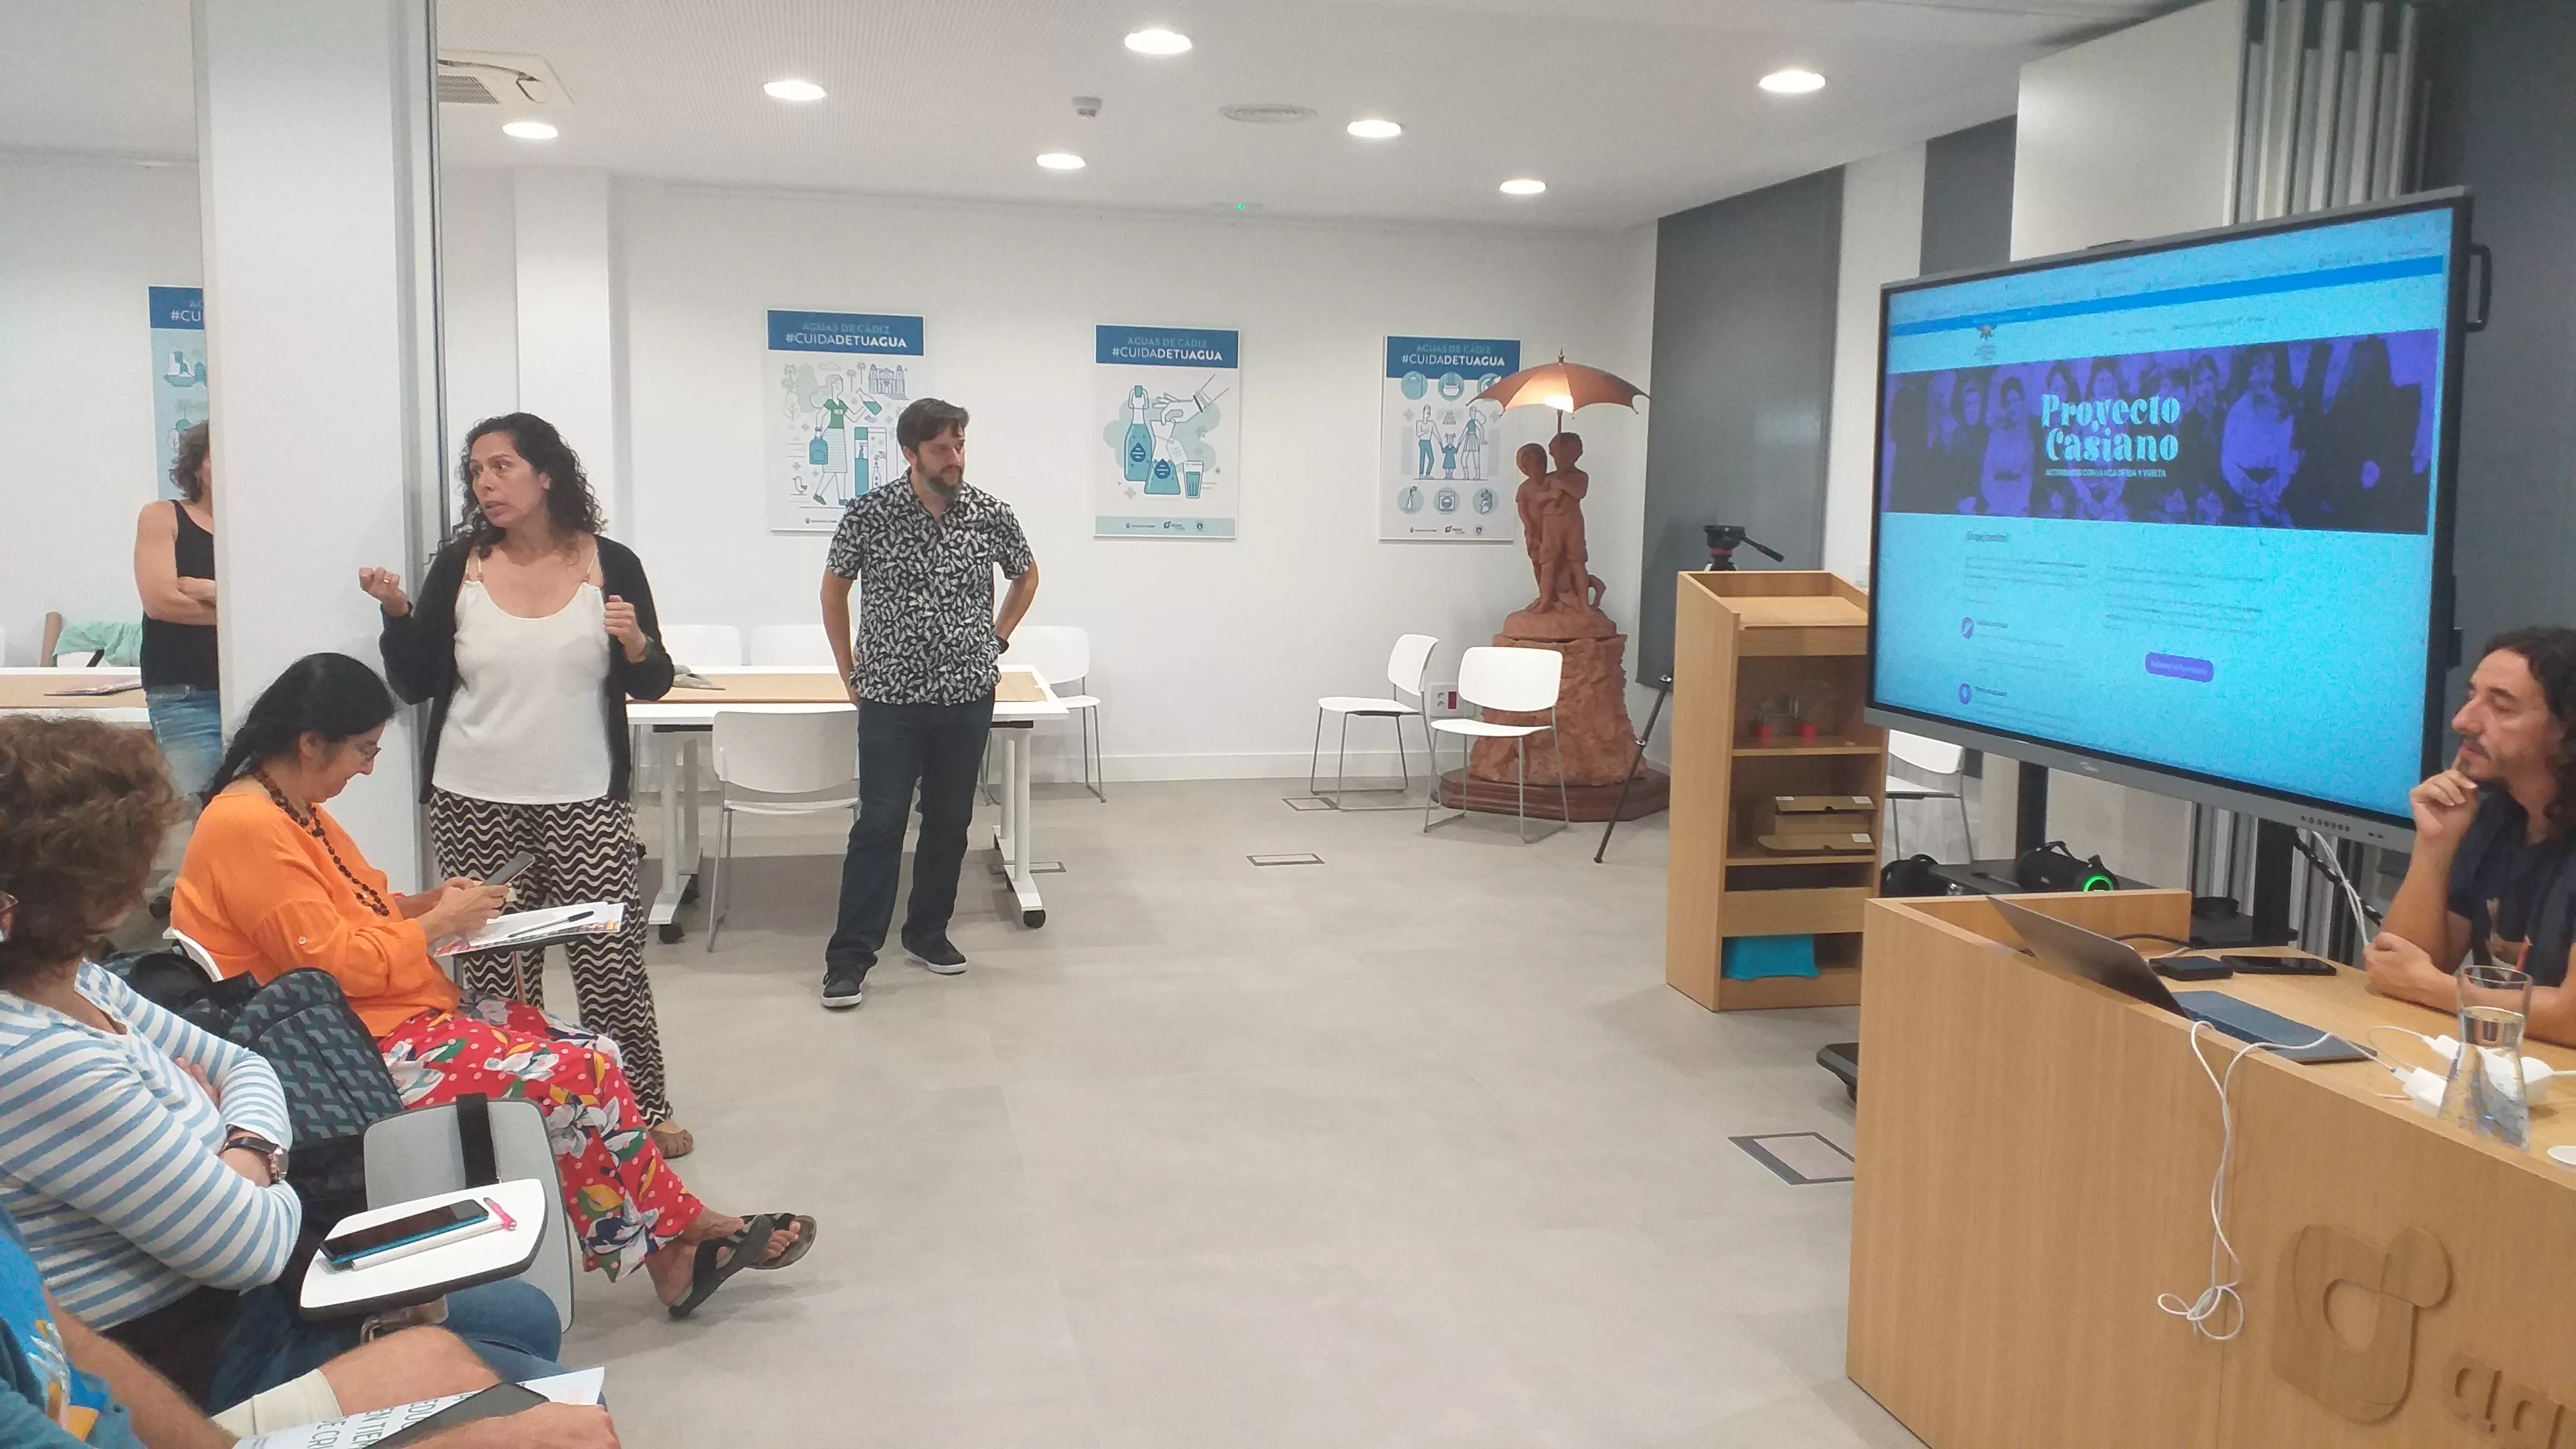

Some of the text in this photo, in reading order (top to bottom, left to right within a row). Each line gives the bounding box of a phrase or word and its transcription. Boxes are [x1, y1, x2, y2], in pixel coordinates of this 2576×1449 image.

[803, 321, 890, 334] AGUAS DE CÁDIZ
[785, 333, 907, 348] #CUIDADETUAGUA
[1128, 336, 1208, 348] AGUAS DE CÁDIZ
[1111, 346, 1222, 361] #CUIDADETUAGUA
[1417, 344, 1491, 354] AGUAS DE CÁDIZ
[1402, 354, 1505, 366] #CUIDADETUAGUA
[2041, 394, 2181, 432] Proyecto
[2046, 427, 2179, 462] Casiano
